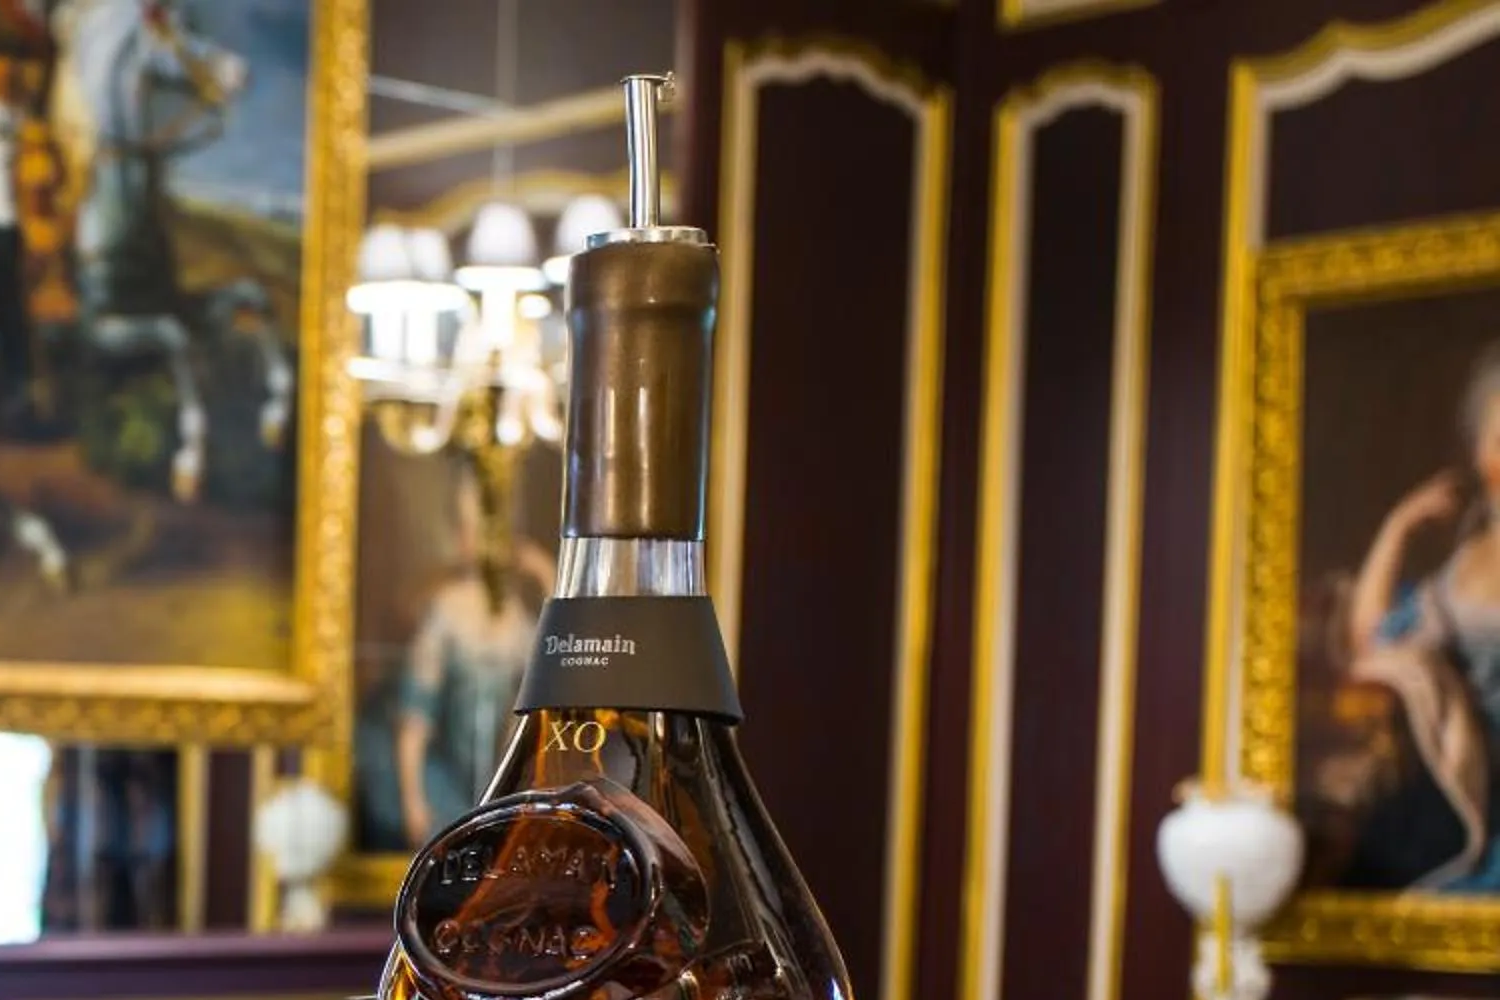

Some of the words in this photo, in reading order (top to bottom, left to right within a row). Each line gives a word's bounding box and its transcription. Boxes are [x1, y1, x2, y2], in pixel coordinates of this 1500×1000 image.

[545, 633, 636, 655] Delamain
[561, 656, 609, 667] COGNAC
[544, 720, 606, 753] XO
